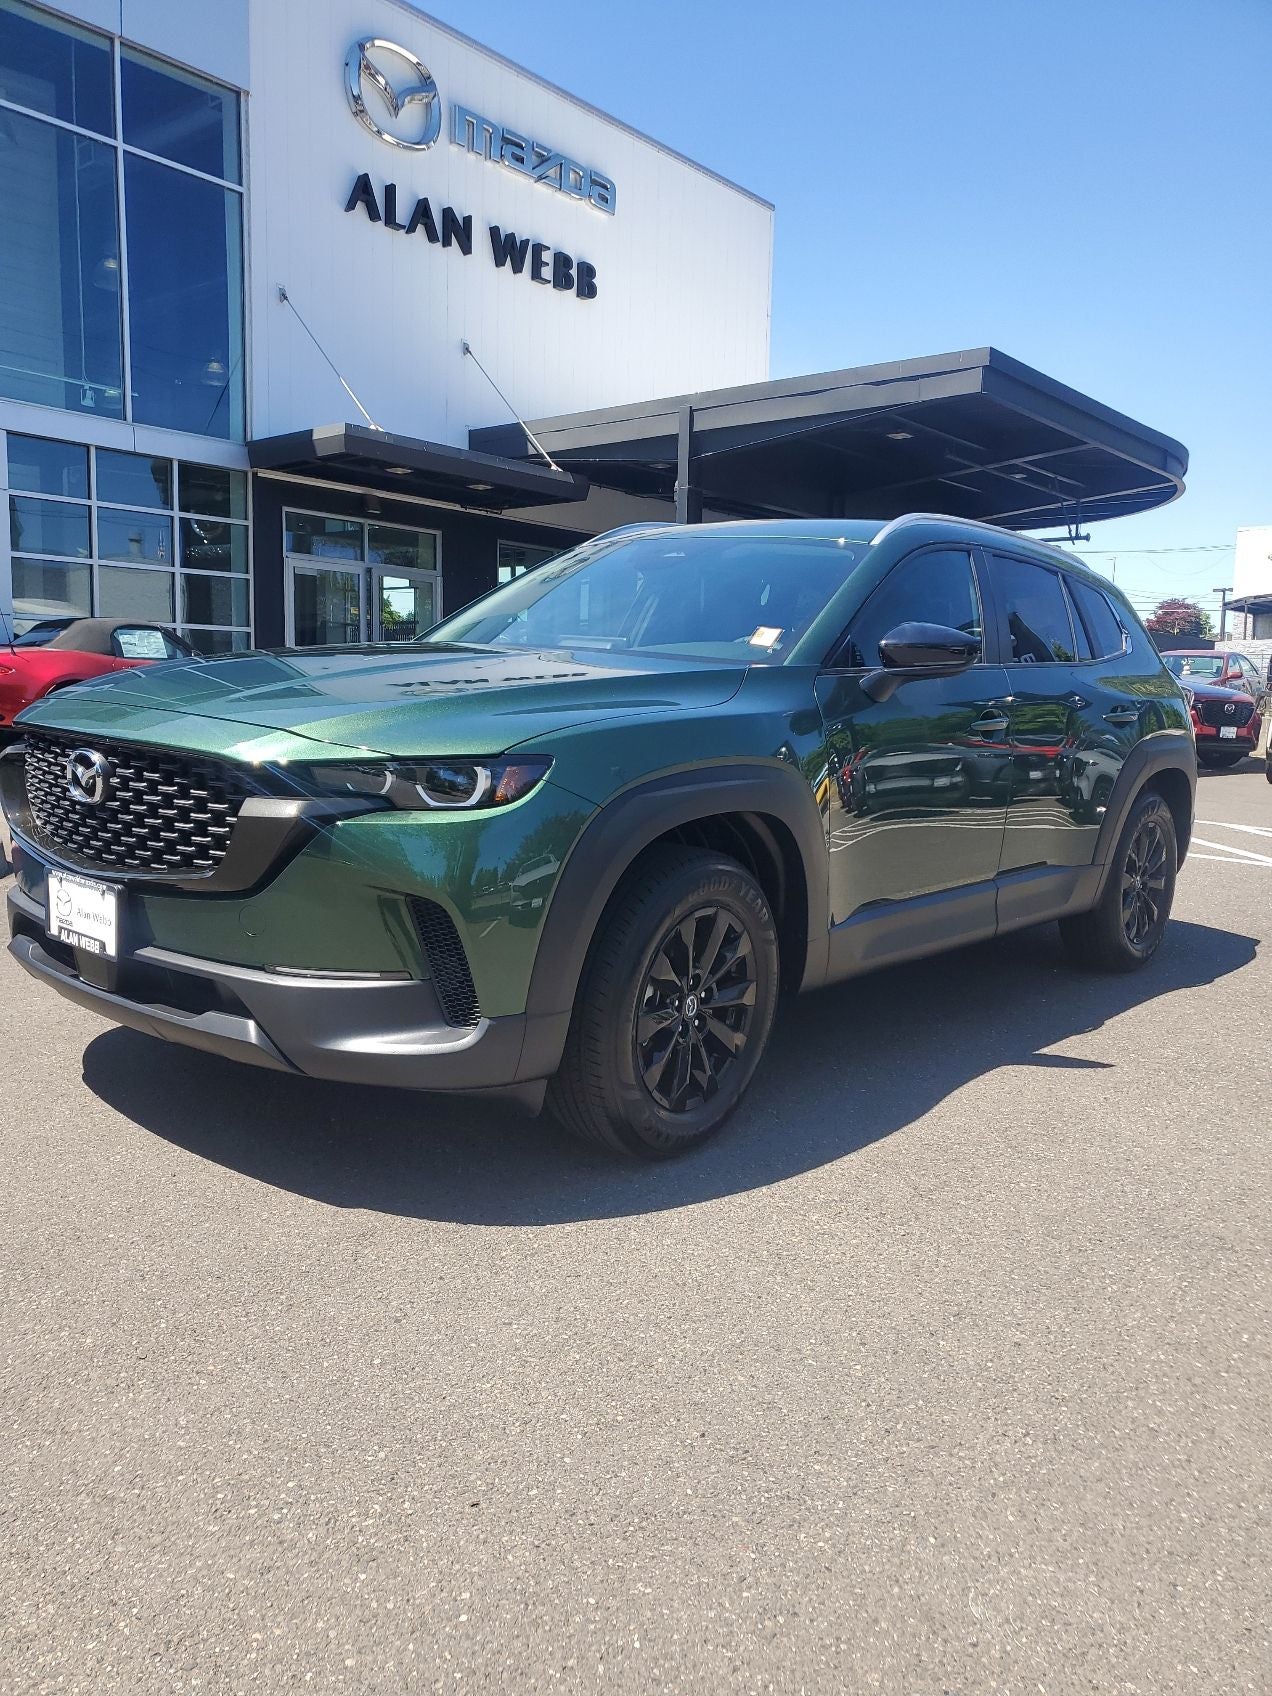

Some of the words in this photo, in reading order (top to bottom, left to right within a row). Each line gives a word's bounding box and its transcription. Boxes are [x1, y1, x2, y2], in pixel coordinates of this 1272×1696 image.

[450, 103, 617, 216] mazda
[344, 172, 473, 256] ALAN
[488, 224, 598, 300] WEBB
[60, 928, 79, 947] ALAN
[79, 935, 101, 954] WEBB
